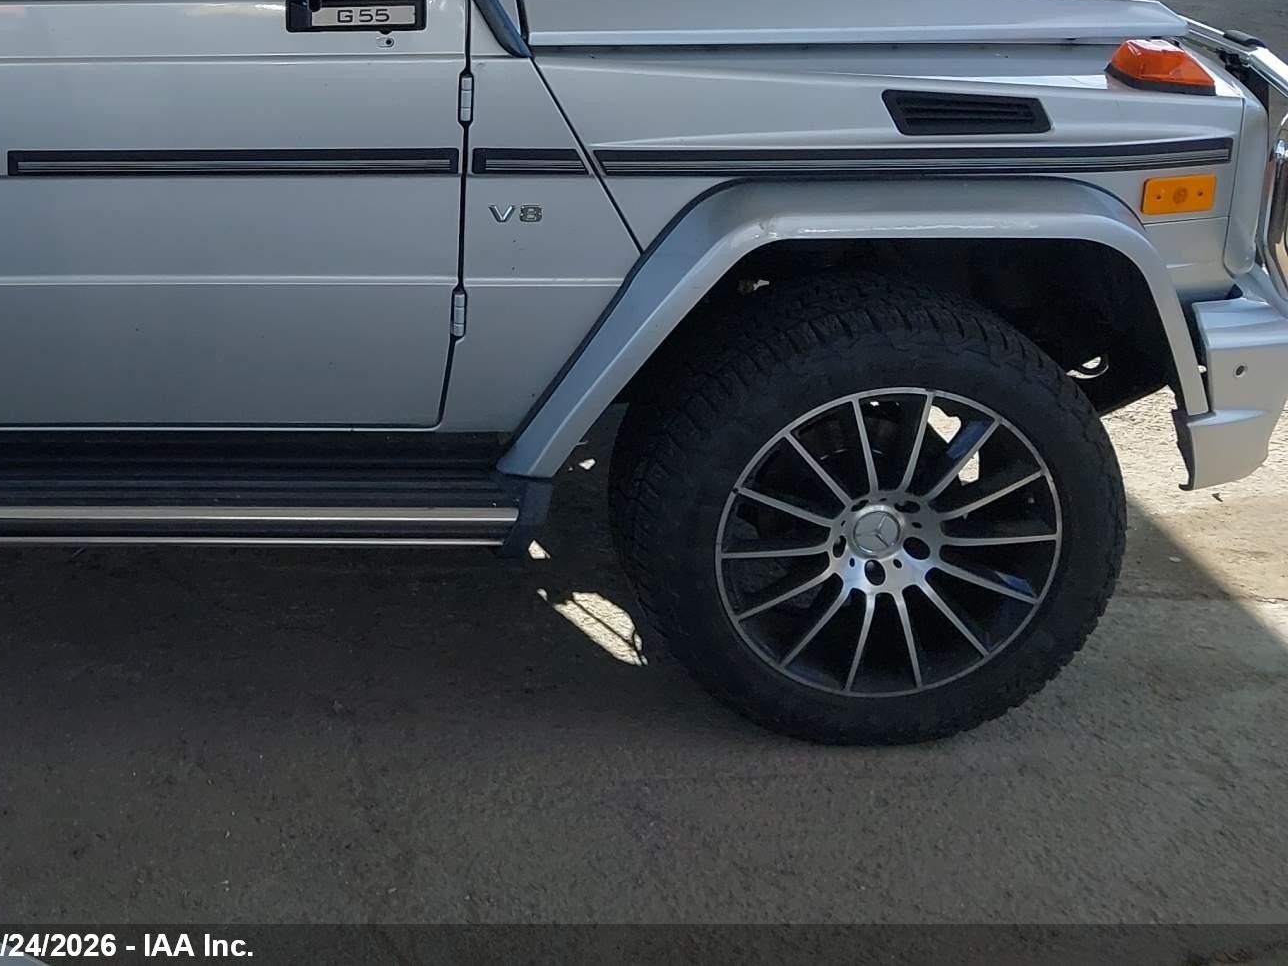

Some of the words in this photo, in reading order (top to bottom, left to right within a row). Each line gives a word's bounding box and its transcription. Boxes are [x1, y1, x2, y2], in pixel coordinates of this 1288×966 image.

[337, 9, 353, 23] G
[359, 9, 390, 22] 55
[489, 204, 543, 223] V8
